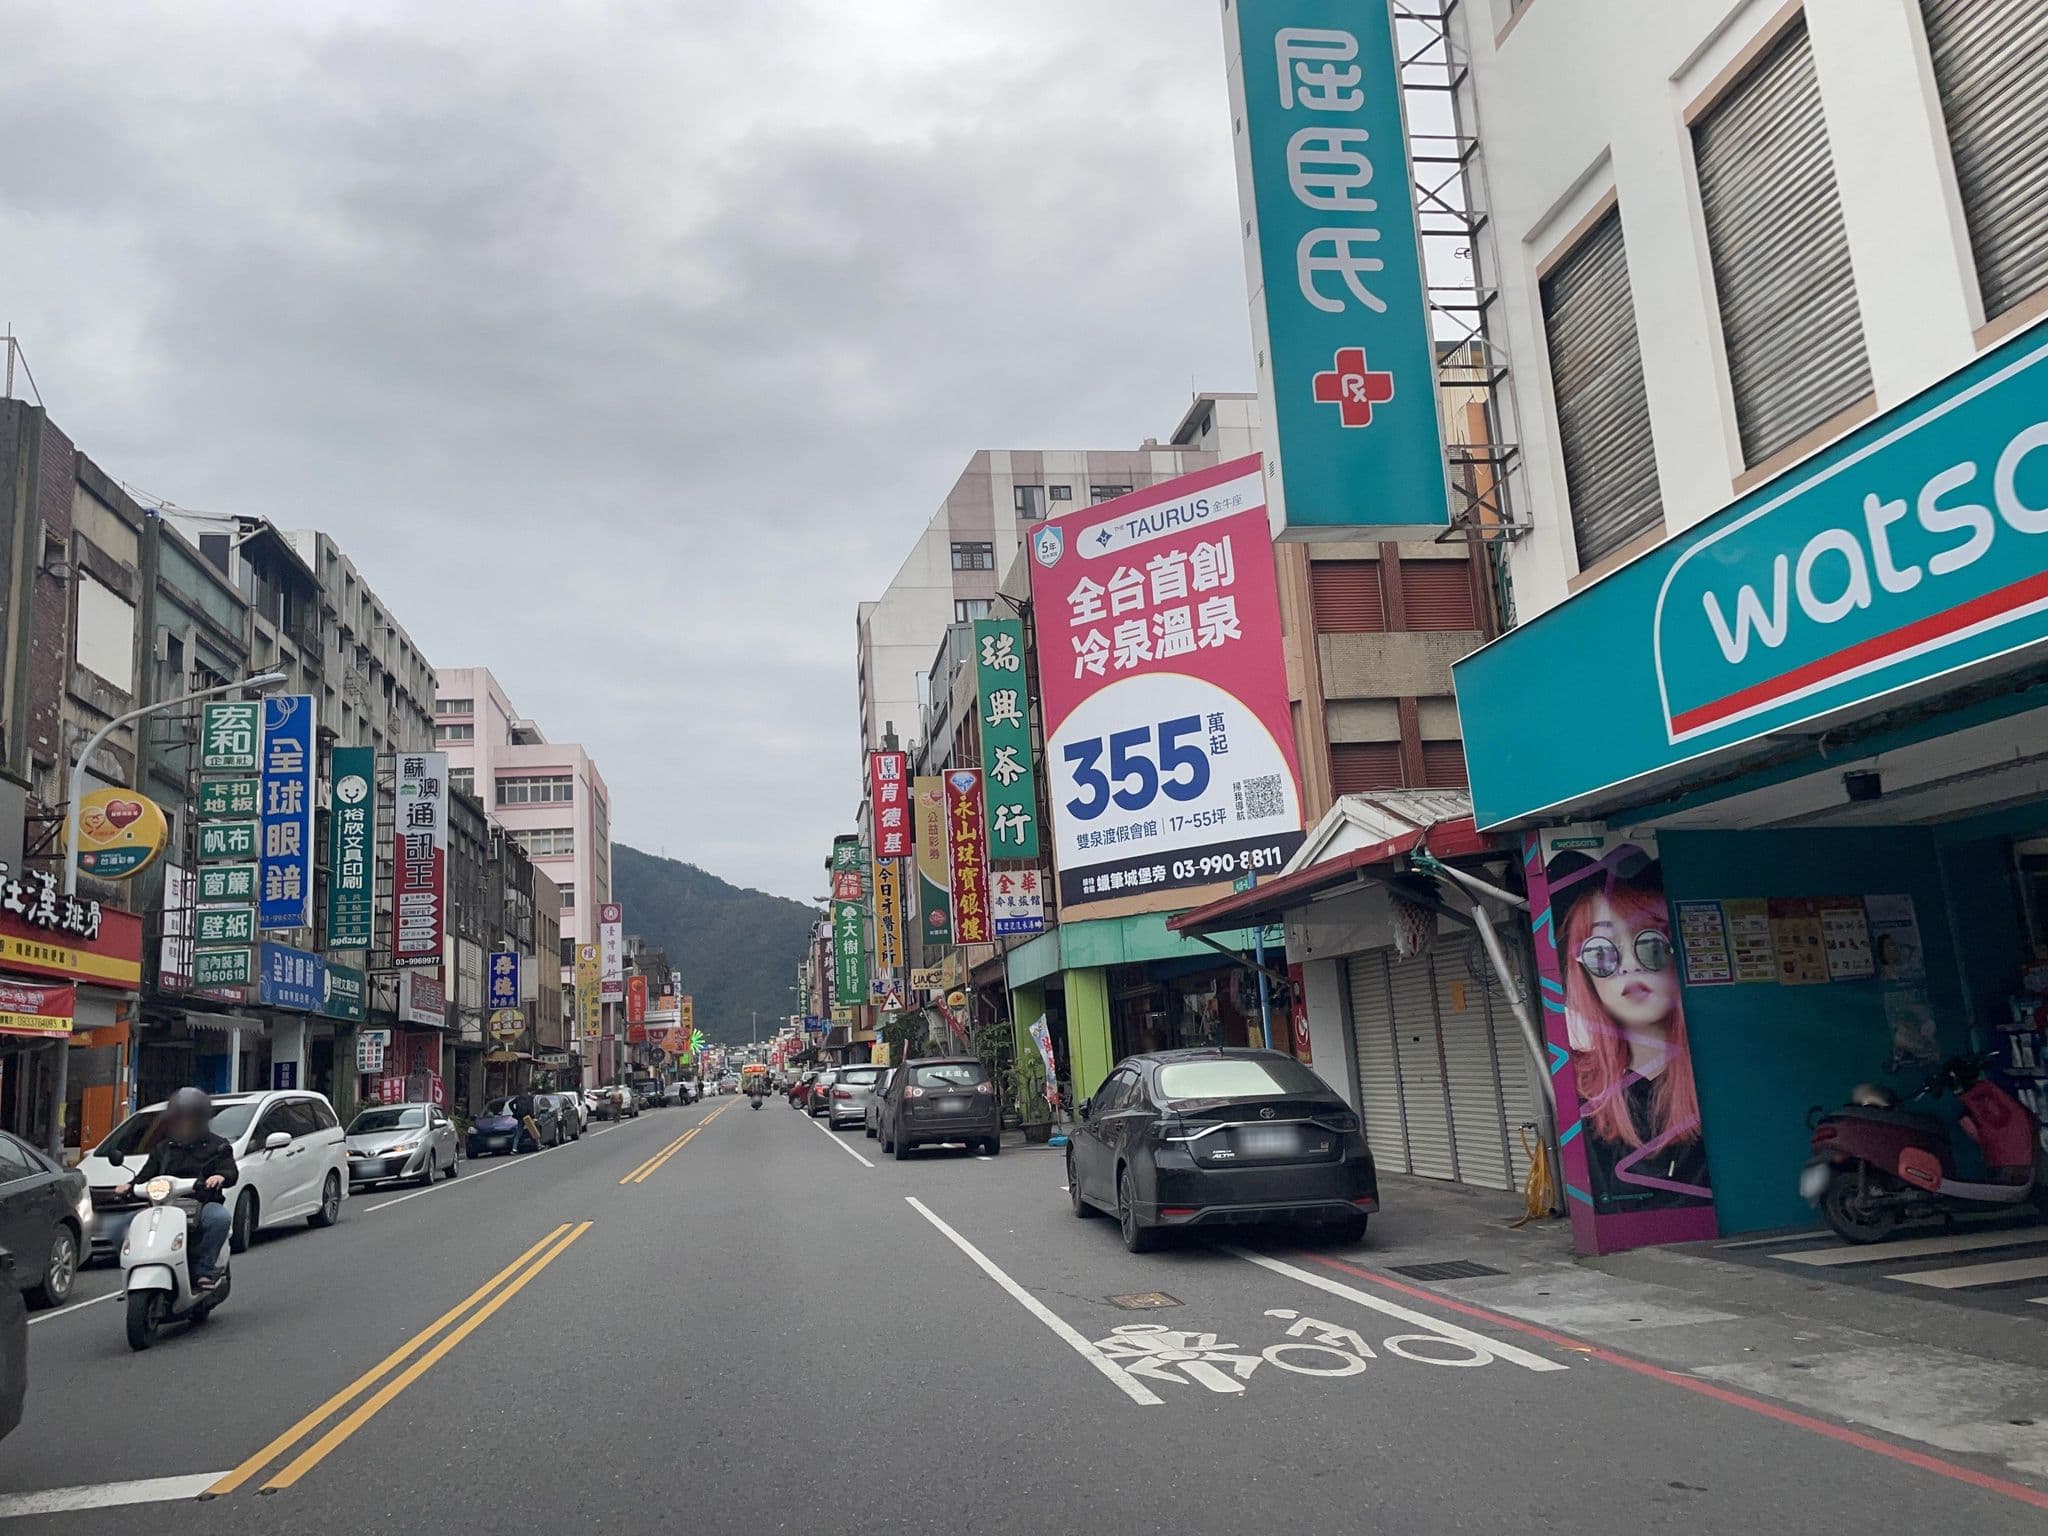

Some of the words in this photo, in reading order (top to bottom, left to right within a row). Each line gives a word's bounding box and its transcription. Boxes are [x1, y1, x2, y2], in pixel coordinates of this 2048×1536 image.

[1275, 27, 1387, 314] 屈臣氏
[1126, 499, 1210, 539] TAURUS
[1212, 494, 1243, 513] 金牛座
[1067, 535, 1236, 628] 全台首創
[1071, 595, 1243, 680] 冷泉溫泉
[209, 705, 252, 754] 宏和
[981, 632, 1032, 846] 瑞興茶行
[1206, 712, 1229, 756] 萬起
[1063, 714, 1211, 821] 355
[204, 827, 250, 853] 帆布
[267, 738, 304, 901] 全球眼鏡
[403, 757, 440, 889] 蘇澳通訊王
[880, 783, 904, 853] 肯德基
[1076, 820, 1158, 850] 雙泉渡假會館
[1169, 808, 1228, 833] 17~55坪
[342, 808, 365, 889] 裕欣文具印刷
[838, 847, 857, 865] 藥
[955, 794, 985, 942] 永山珠寶銀樓
[1172, 846, 1283, 880] 03-990-8811
[204, 871, 250, 896] 窗簾
[996, 872, 1037, 894] 金華
[201, 913, 248, 939] 壁紙
[843, 923, 858, 955] 大樹
[878, 867, 897, 964] 今日牙醫診所
